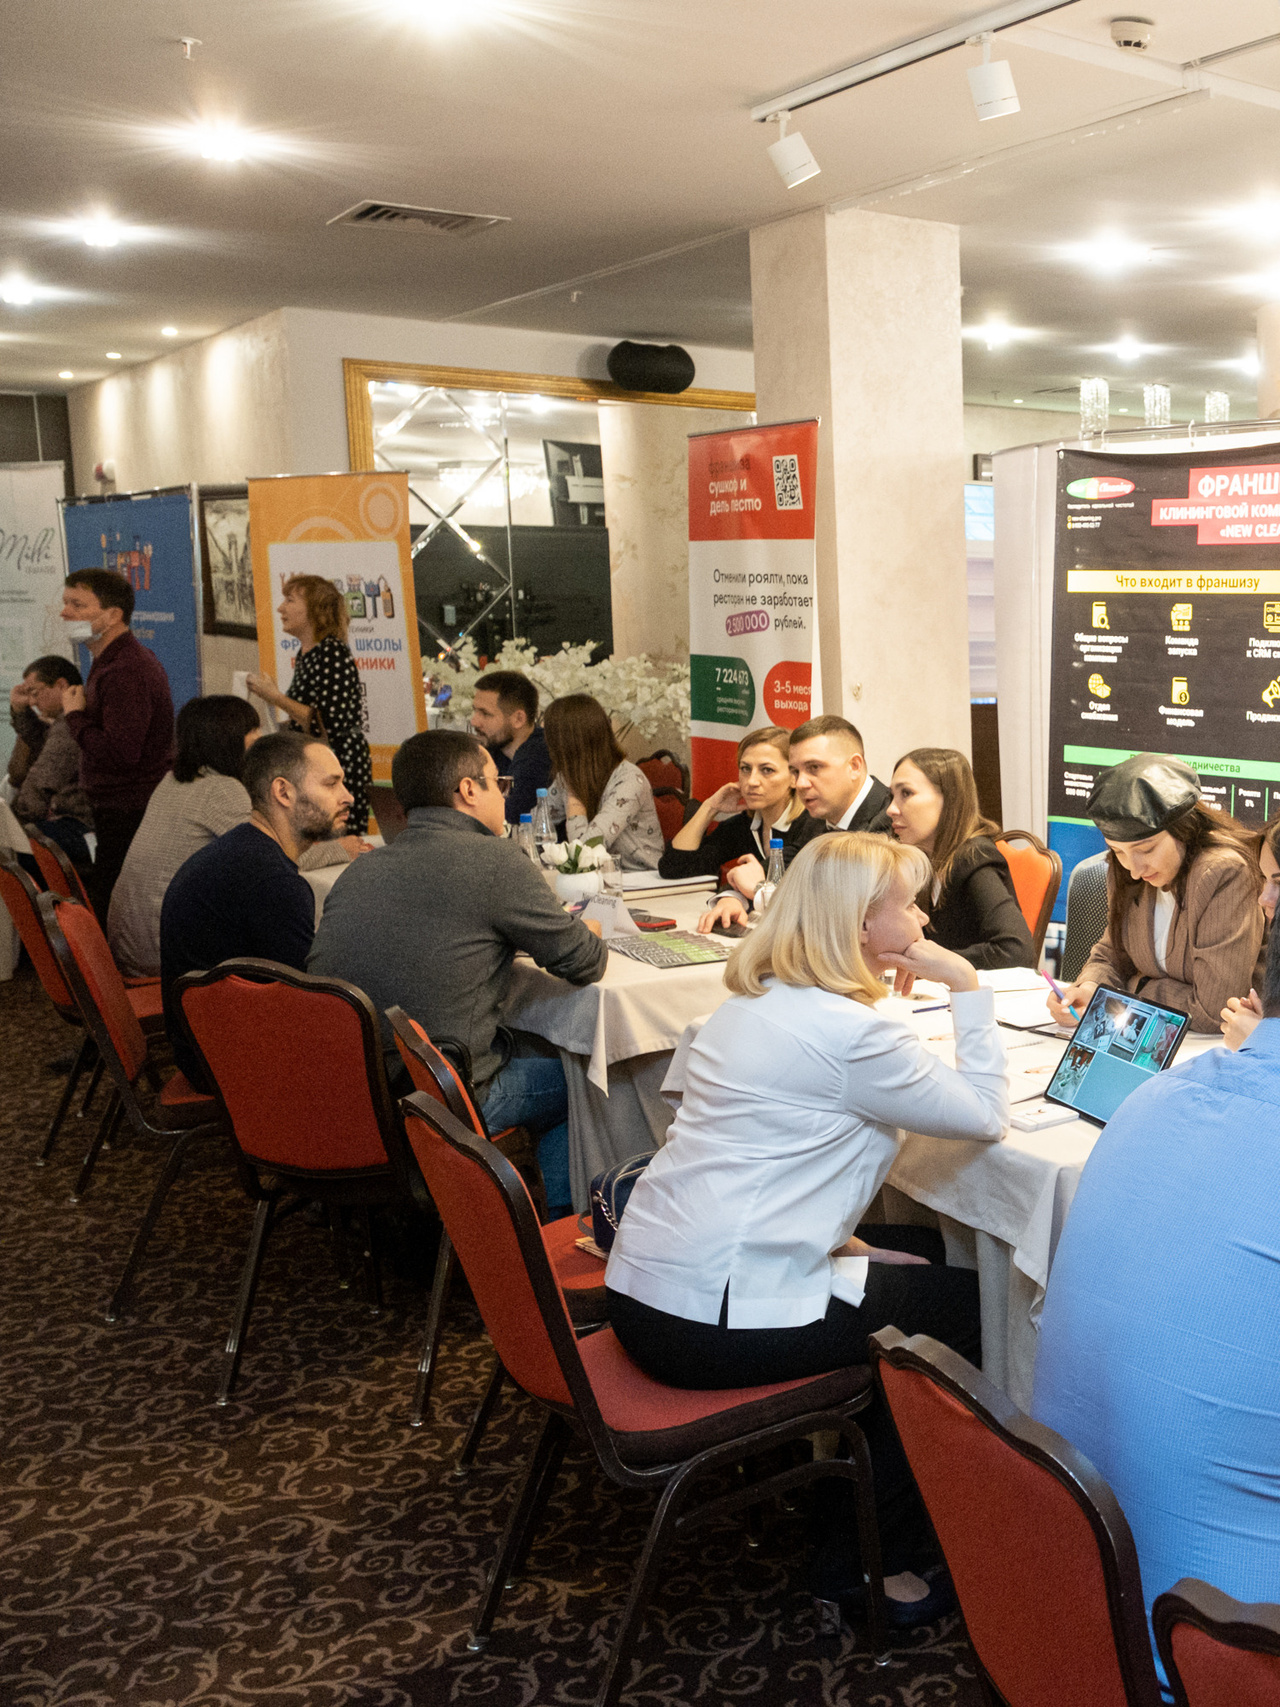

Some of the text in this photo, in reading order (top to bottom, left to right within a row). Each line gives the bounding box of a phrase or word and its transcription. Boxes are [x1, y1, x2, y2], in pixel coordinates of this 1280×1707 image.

[1159, 502, 1249, 521] КЛИНИНГОВОЙ
[786, 573, 808, 585] пока
[1116, 574, 1260, 591] Что входит в франшизу
[745, 594, 757, 606] не
[760, 594, 813, 609] заработает
[355, 637, 402, 652] ШКОЛЫ
[774, 680, 791, 694] 3-5
[774, 699, 808, 712] выхода
